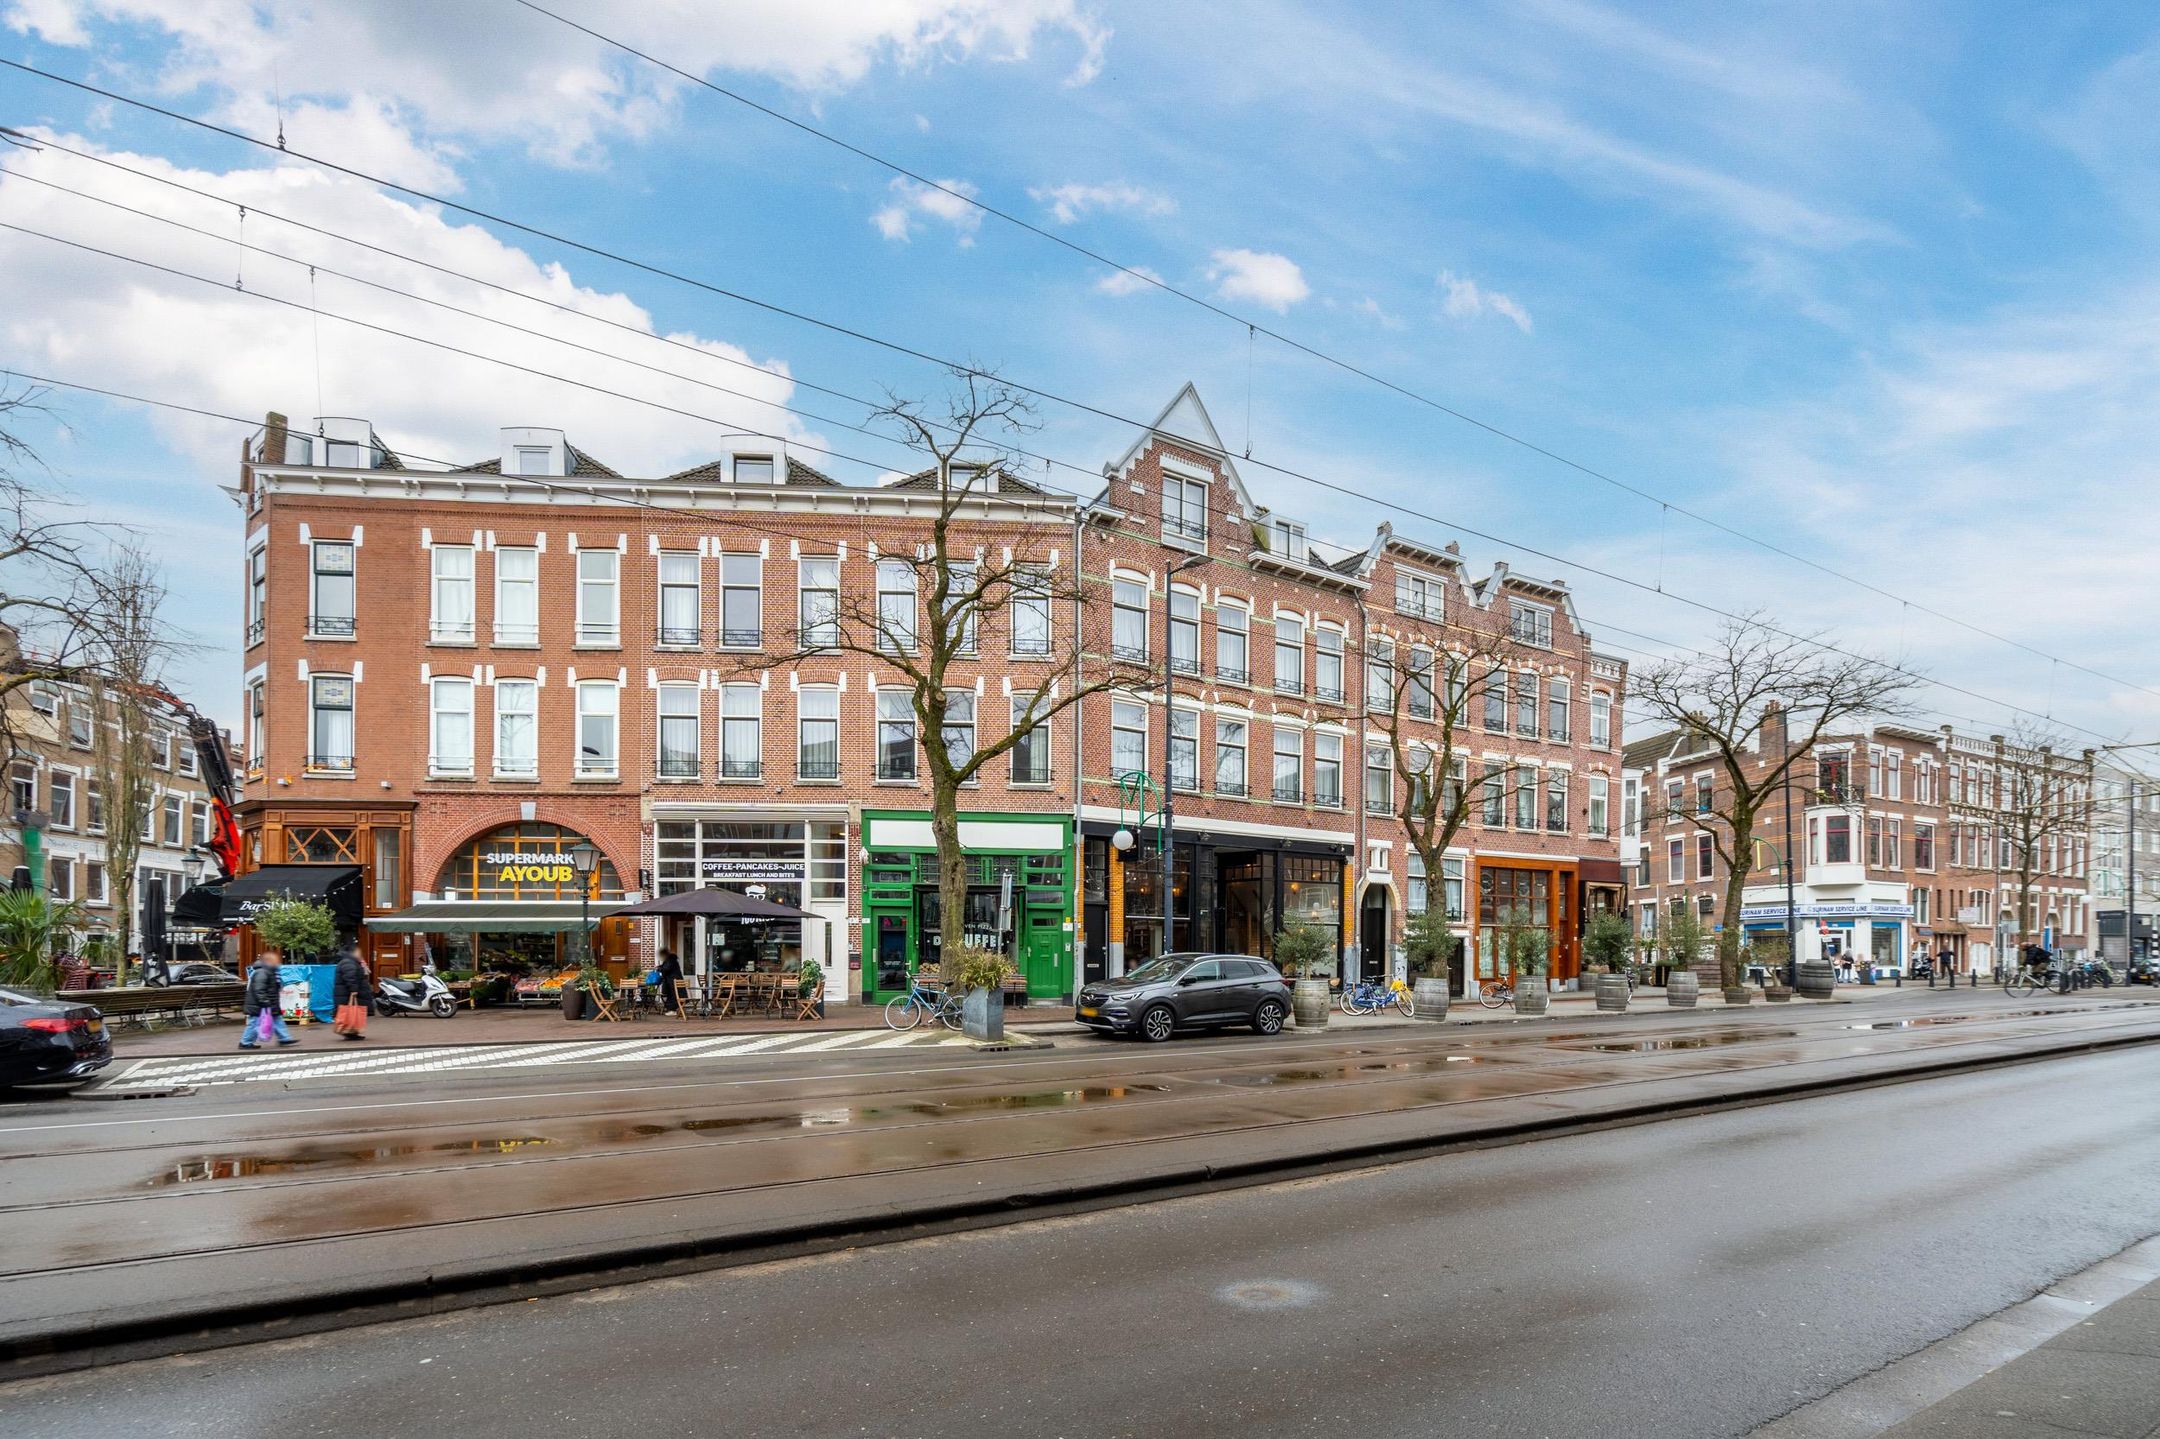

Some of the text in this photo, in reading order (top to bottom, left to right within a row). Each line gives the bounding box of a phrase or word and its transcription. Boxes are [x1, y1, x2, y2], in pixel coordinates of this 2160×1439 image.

[486, 853, 576, 865] SUPERMARK
[499, 866, 573, 882] AYOUB
[239, 900, 263, 912] Bar
